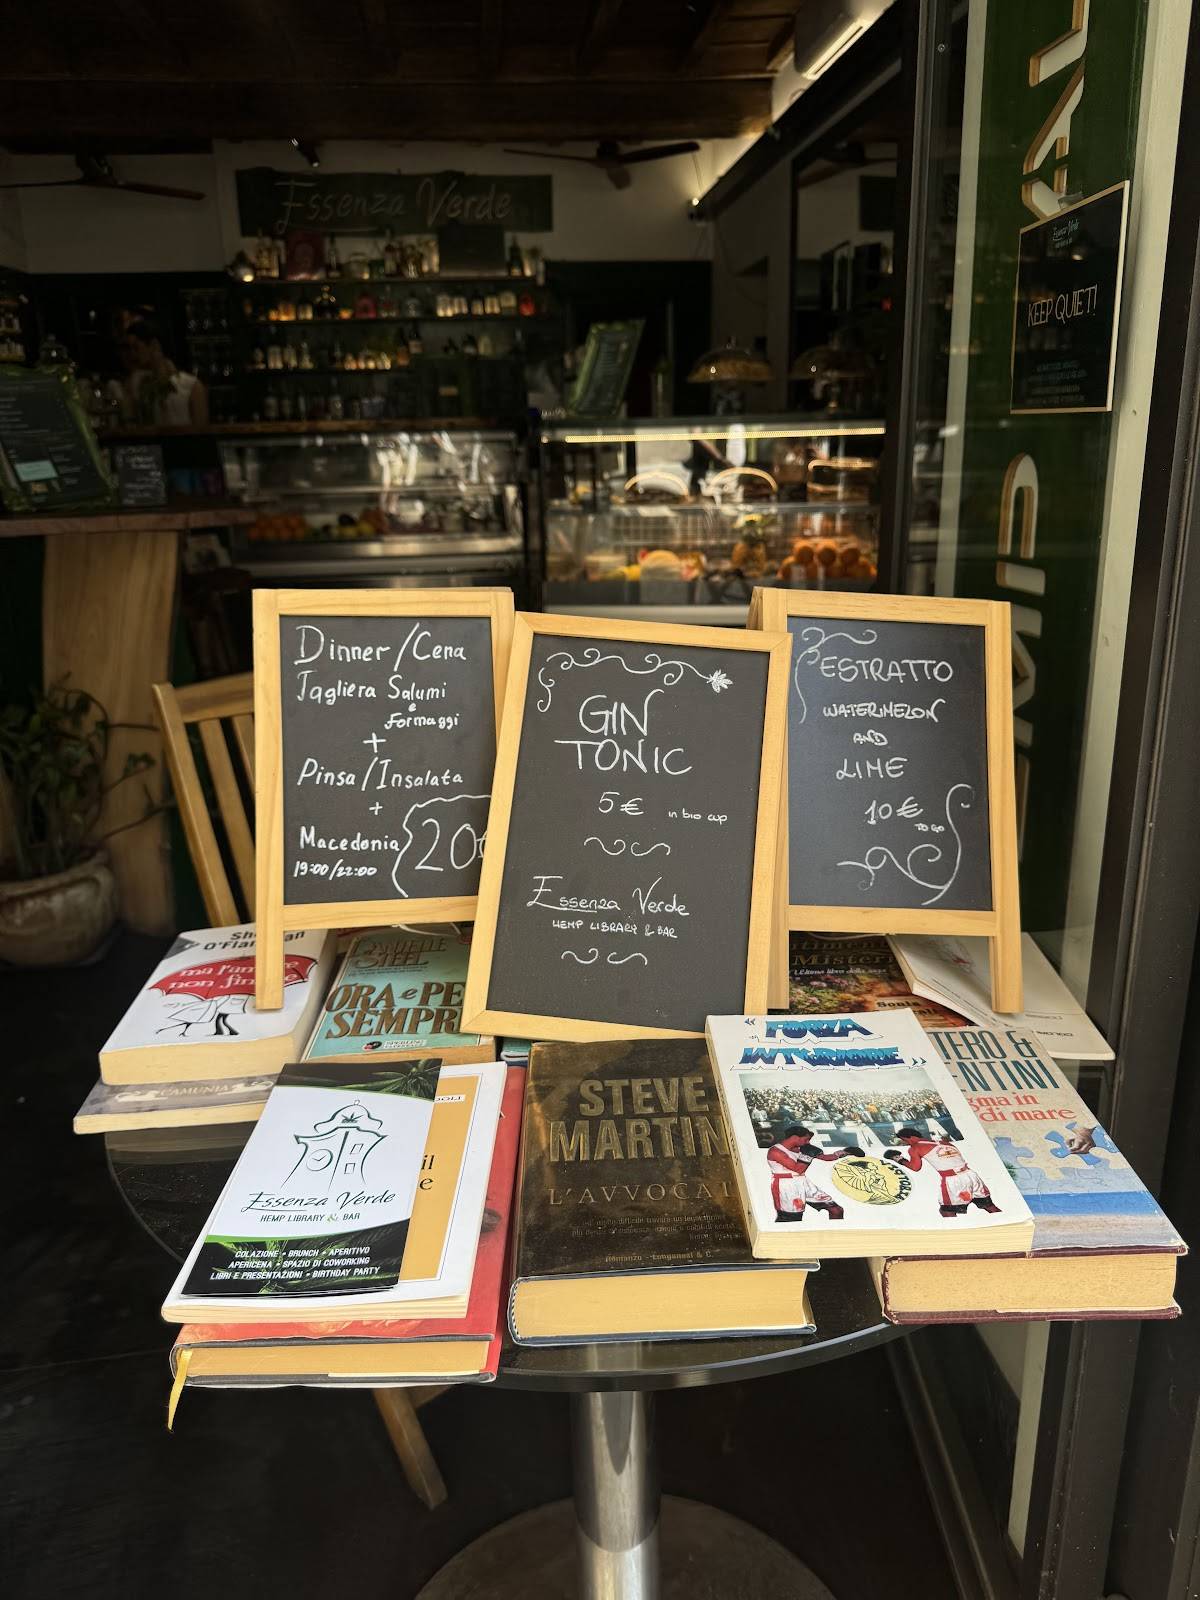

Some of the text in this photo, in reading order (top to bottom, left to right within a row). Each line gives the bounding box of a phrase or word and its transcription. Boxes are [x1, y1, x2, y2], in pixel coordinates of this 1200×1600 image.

[273, 176, 513, 235] Essenza Verde
[1027, 283, 1098, 327] KEEP QUIET!
[820, 656, 953, 683] ESTRATTO
[387, 674, 447, 701] Salumi
[384, 713, 460, 729] Formaggi
[579, 689, 664, 736] GIN
[823, 699, 946, 722] WATERMELON
[853, 730, 888, 746] AND
[554, 739, 692, 775] TONIC
[836, 757, 907, 780] LIME
[668, 811, 678, 819] in
[682, 808, 701, 820] bio
[708, 813, 728, 823] cup
[300, 825, 400, 851] Macedonia
[526, 876, 690, 916] Essenza Verde
[552, 920, 584, 930] HEMP
[589, 922, 637, 934] LIBRARY
[657, 926, 678, 938] BAR
[354, 952, 430, 969] STEEL
[169, 980, 214, 989] non
[325, 981, 467, 1012] ORA e PE
[325, 1008, 462, 1039] SEMPR
[927, 1030, 1038, 1060] TERO &
[578, 1076, 710, 1117] STEVE
[1013, 1091, 1039, 1105] in
[979, 1108, 1078, 1122] di mare
[550, 1115, 730, 1162] MARTIN
[240, 1190, 396, 1212] Essenza Verde
[549, 1182, 733, 1205] L'AVVOCAT
[288, 1214, 325, 1222] LIBRARY
[228, 1257, 370, 1269] APERICENA SPAZIO DI COWORKING
[235, 1250, 279, 1258] COLAZIONE
[329, 1247, 370, 1256] APERITIVO
[210, 1272, 231, 1280] LIBRI
[241, 1271, 303, 1280] PRESENTAZIONI
[312, 1269, 350, 1278] BIRTHDAY
[353, 1266, 380, 1276] PARTY
